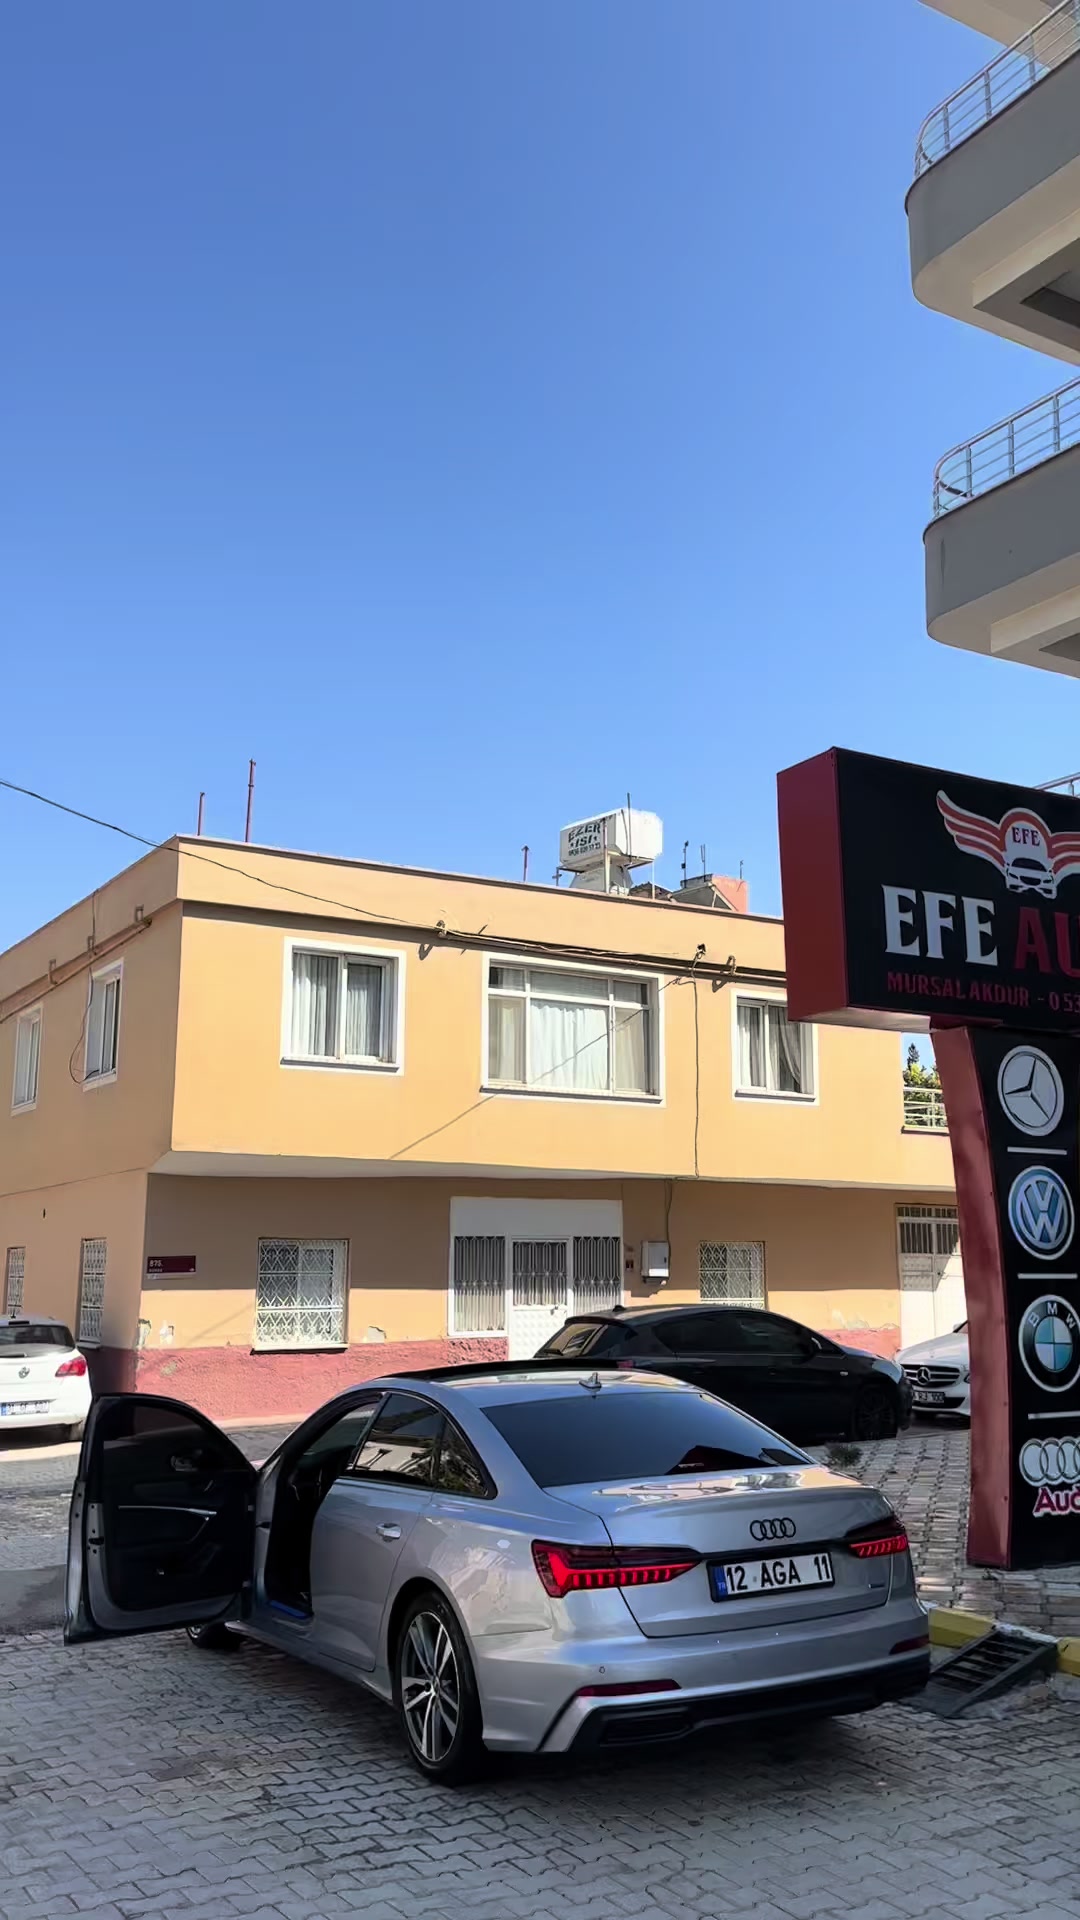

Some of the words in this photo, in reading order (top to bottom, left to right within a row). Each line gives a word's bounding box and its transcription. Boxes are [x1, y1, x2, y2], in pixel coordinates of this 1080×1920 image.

[1011, 827, 1041, 847] EFE
[881, 884, 998, 967] EFE
[969, 979, 1029, 1008] AKDUR
[1028, 1301, 1077, 1329] BMW
[726, 1565, 748, 1592] 12
[760, 1559, 801, 1588] AGA
[813, 1555, 830, 1581] 11
